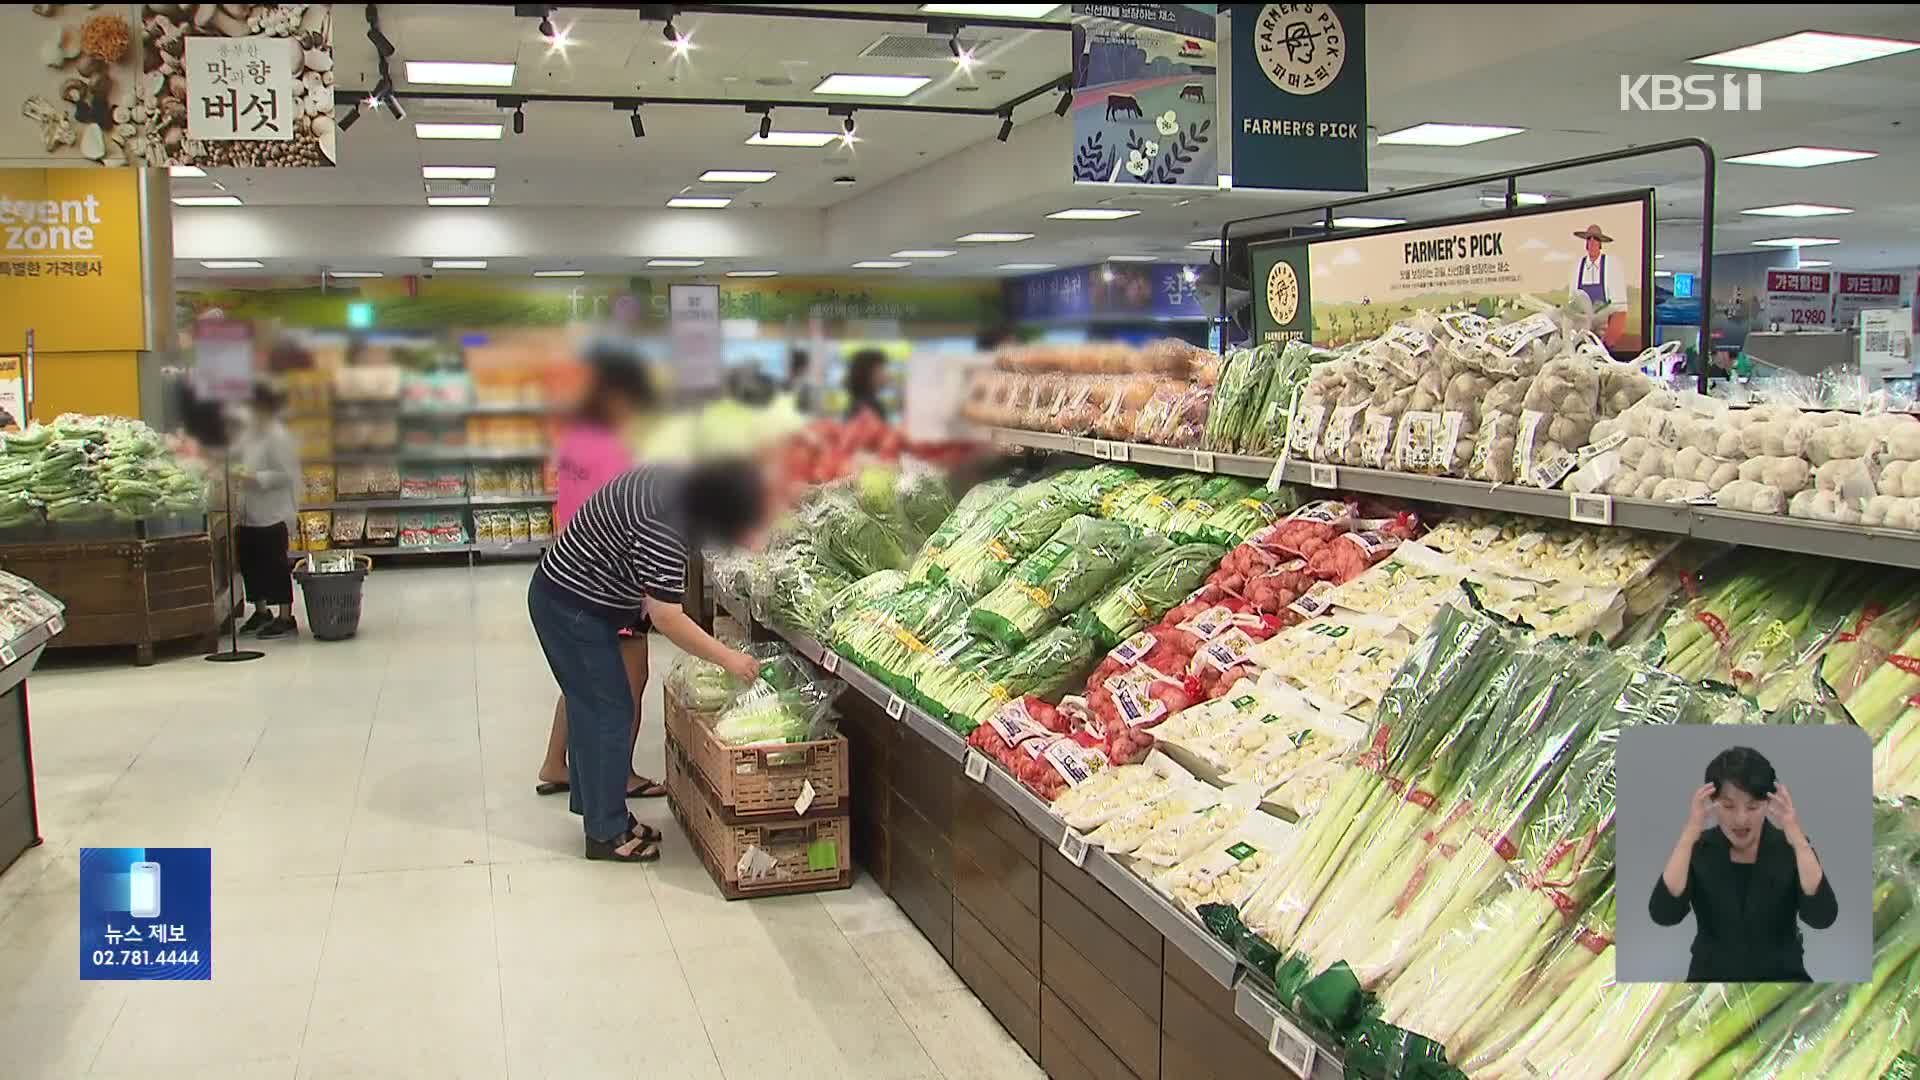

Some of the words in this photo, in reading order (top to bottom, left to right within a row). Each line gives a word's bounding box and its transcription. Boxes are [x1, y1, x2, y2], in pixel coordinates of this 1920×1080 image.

[1318, 12, 1340, 58] PICK
[201, 88, 279, 133] 버섯
[1243, 119, 1315, 137] FARMER'S
[1319, 122, 1358, 138] PICK
[5, 225, 94, 250] zone
[1404, 235, 1467, 264] FARMER'S
[1470, 232, 1503, 258] PICK
[45, 261, 102, 277] 가격행사
